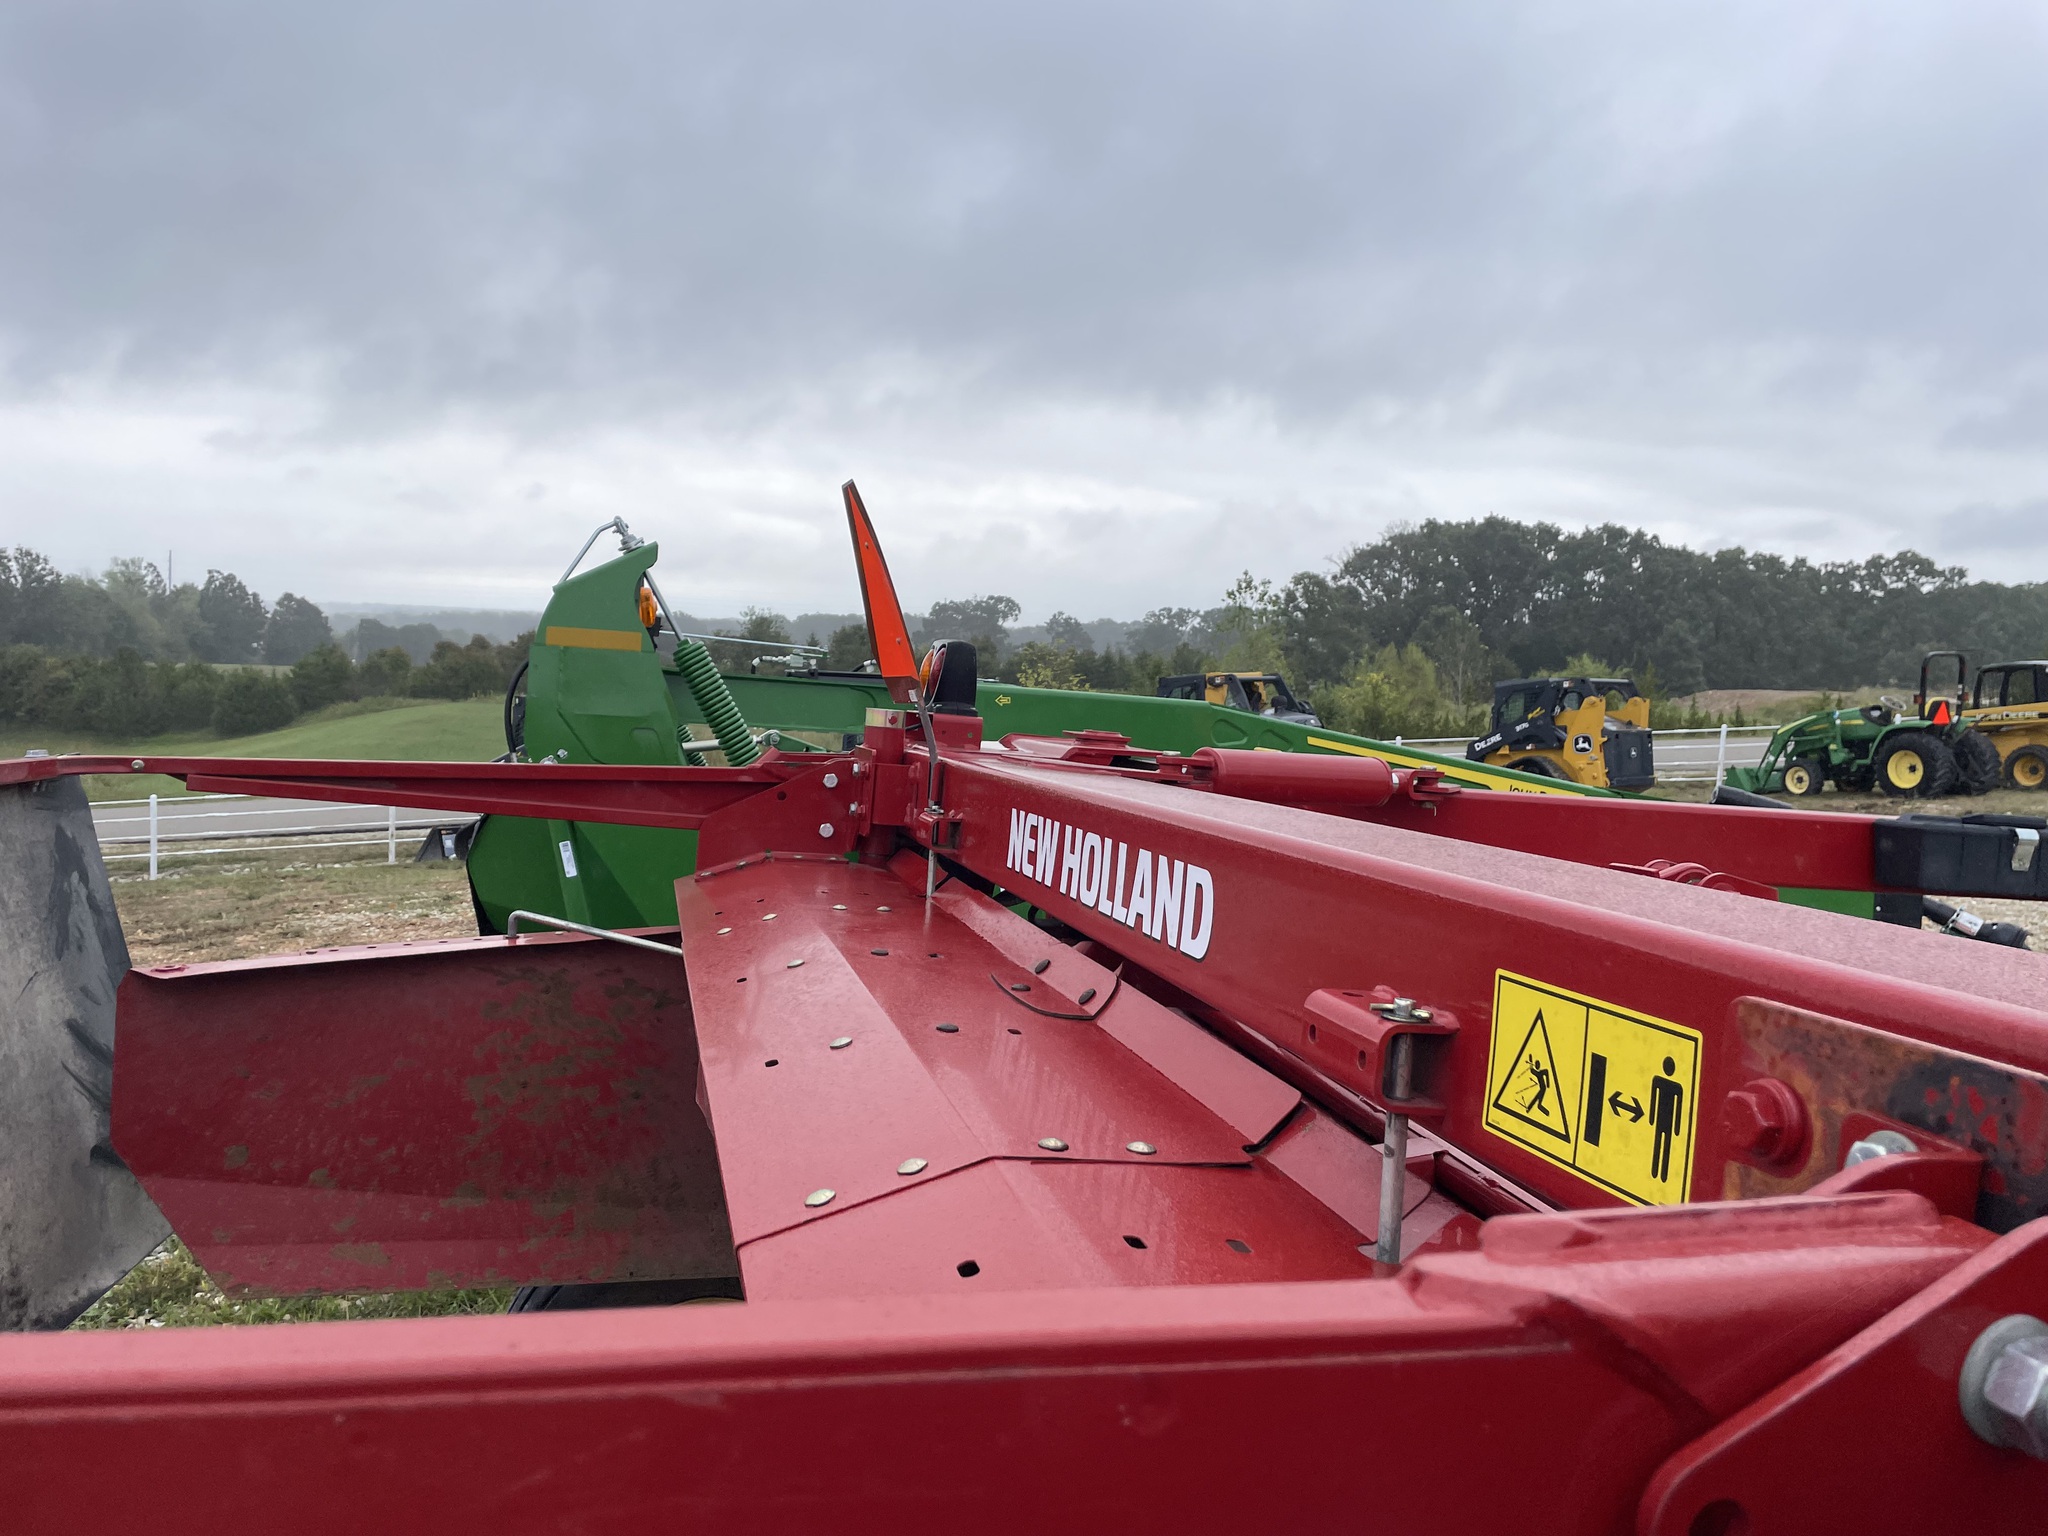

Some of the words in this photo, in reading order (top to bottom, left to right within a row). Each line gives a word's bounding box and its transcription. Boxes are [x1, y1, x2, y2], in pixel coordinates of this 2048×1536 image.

[2003, 711, 2039, 721] DEERE
[1474, 733, 1502, 751] DEERE
[1006, 807, 1060, 888] NEW
[1059, 824, 1214, 960] HOLLAND
